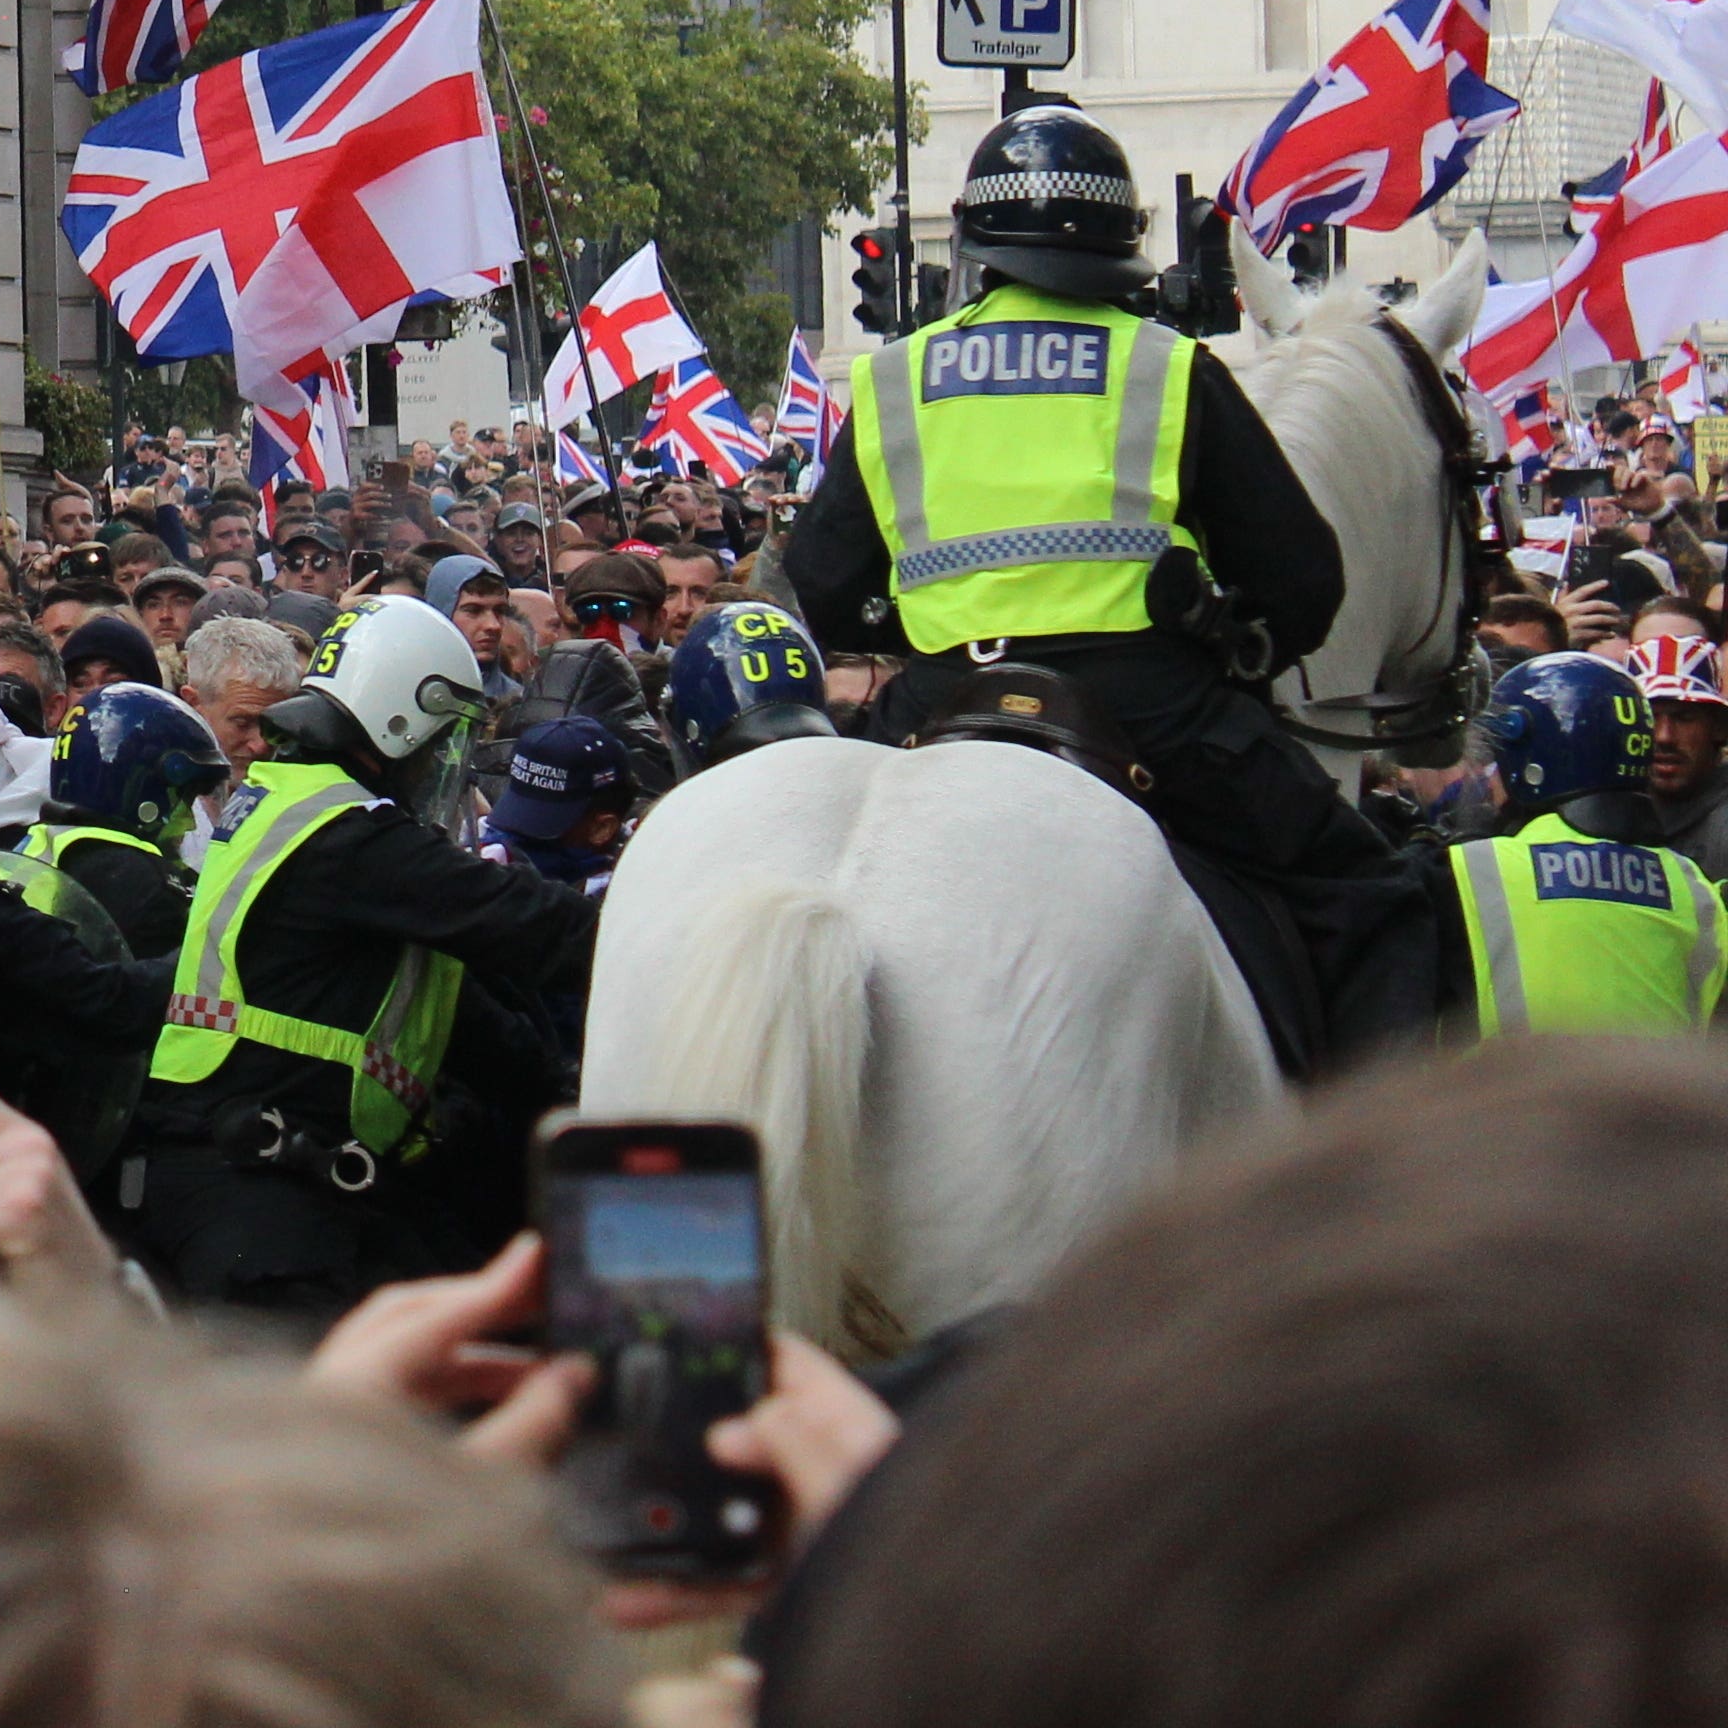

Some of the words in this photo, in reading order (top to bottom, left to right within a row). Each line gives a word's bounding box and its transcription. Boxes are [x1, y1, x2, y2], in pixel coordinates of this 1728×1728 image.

[972, 40, 1042, 58] Trafalgar
[929, 333, 1100, 386] POLICE
[735, 613, 790, 638] CP
[529, 761, 569, 780] BRITAIN
[532, 775, 566, 791] AGAIN
[1538, 849, 1666, 898] POLICE
